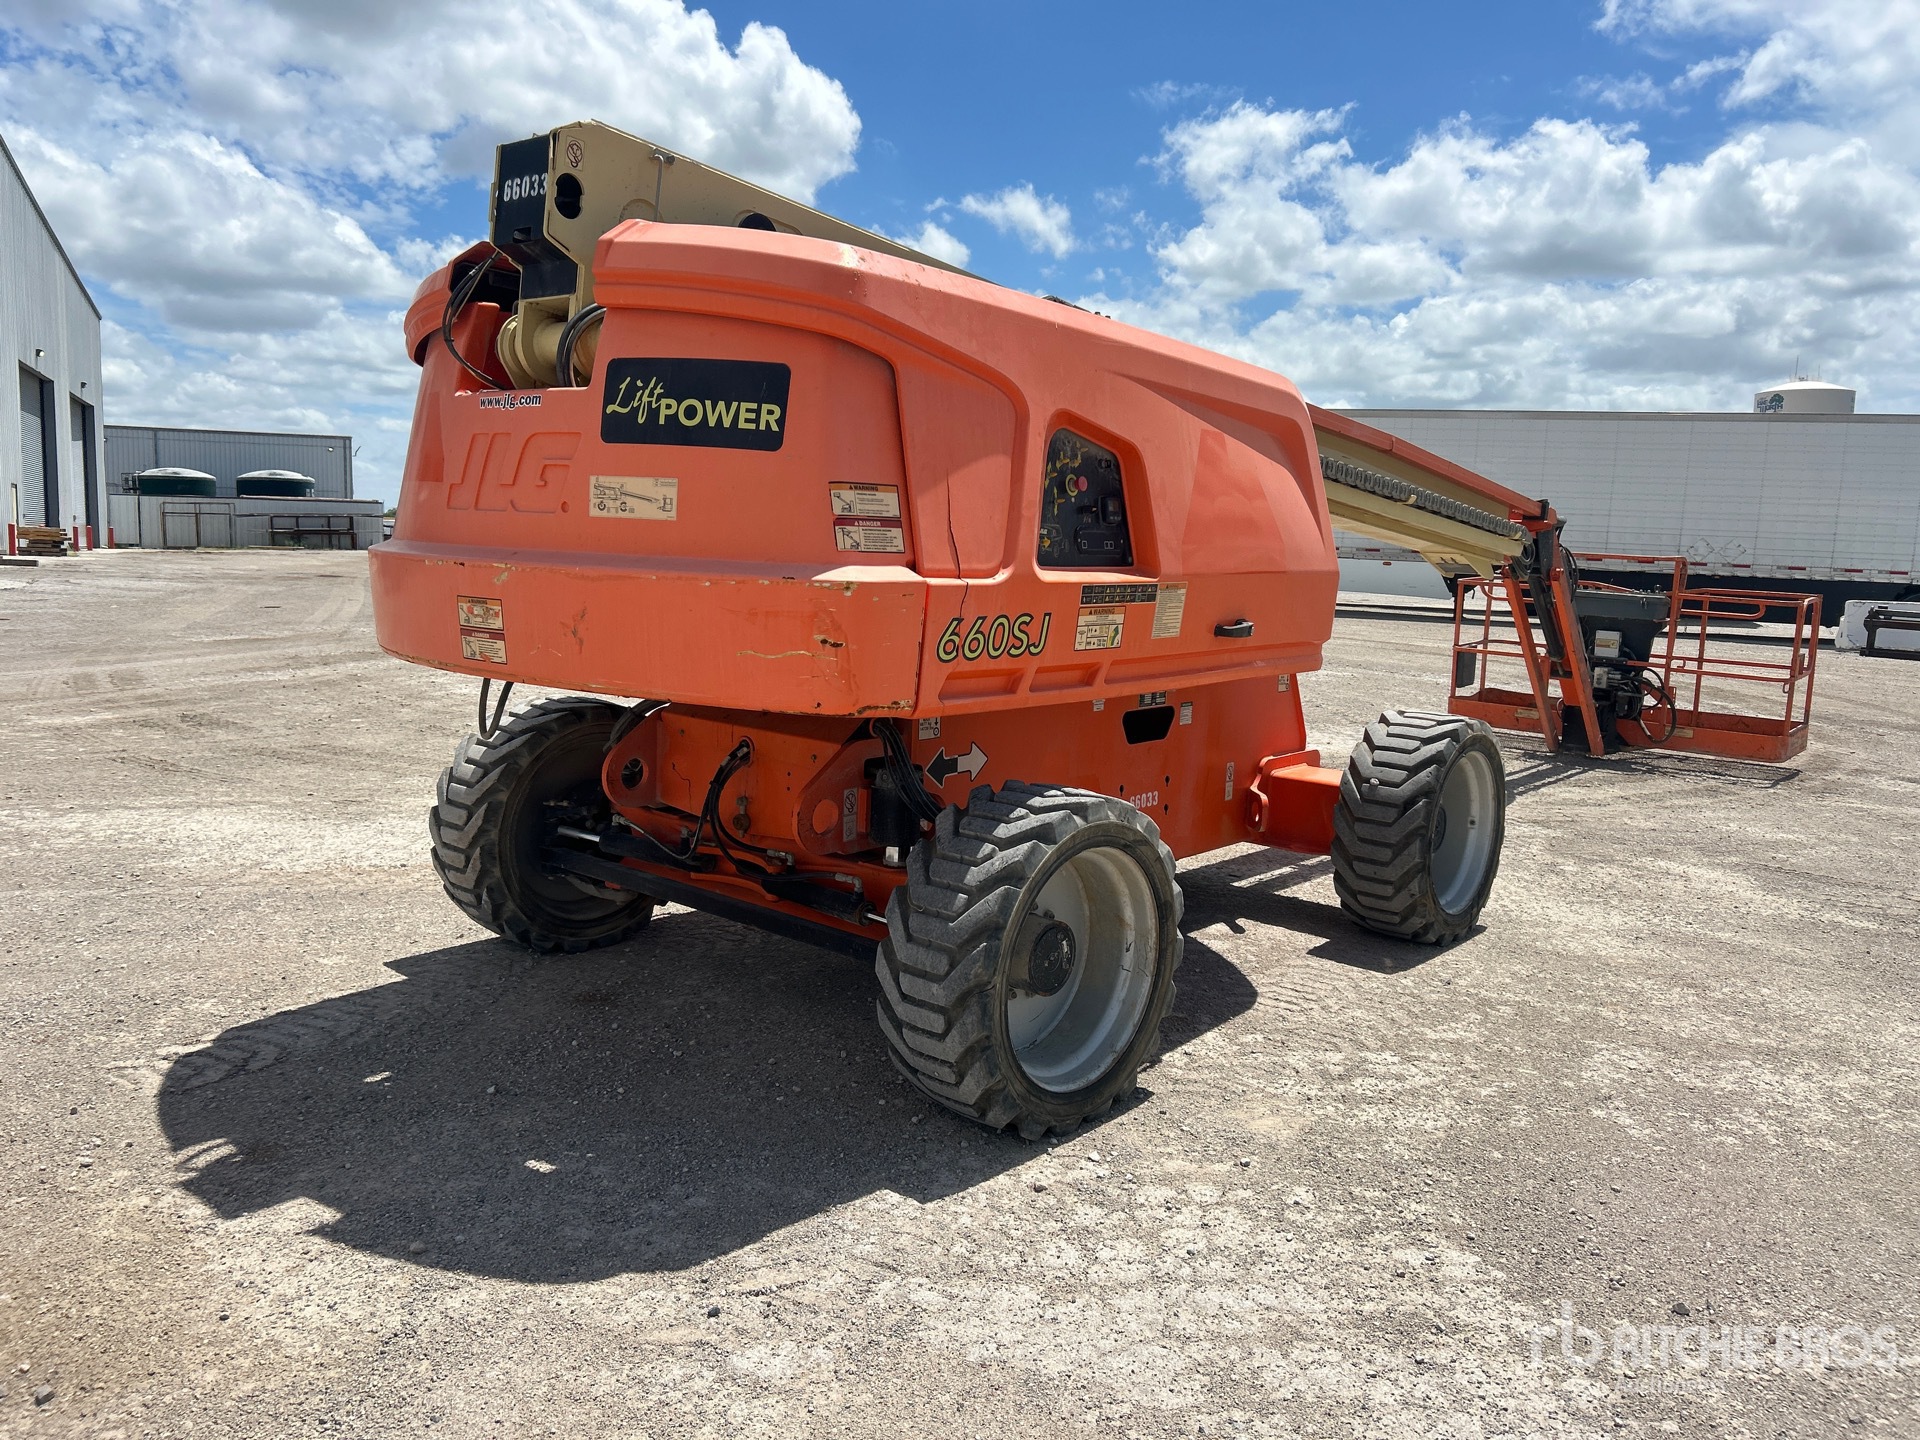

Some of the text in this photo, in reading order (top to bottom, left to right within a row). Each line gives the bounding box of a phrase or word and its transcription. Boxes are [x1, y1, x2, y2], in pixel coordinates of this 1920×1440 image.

[503, 172, 548, 202] 66033
[480, 393, 542, 410] www.jlg.com
[606, 376, 781, 432] Lift POWER
[1093, 607, 1116, 615] WARNING
[936, 612, 1052, 664] 660SJ
